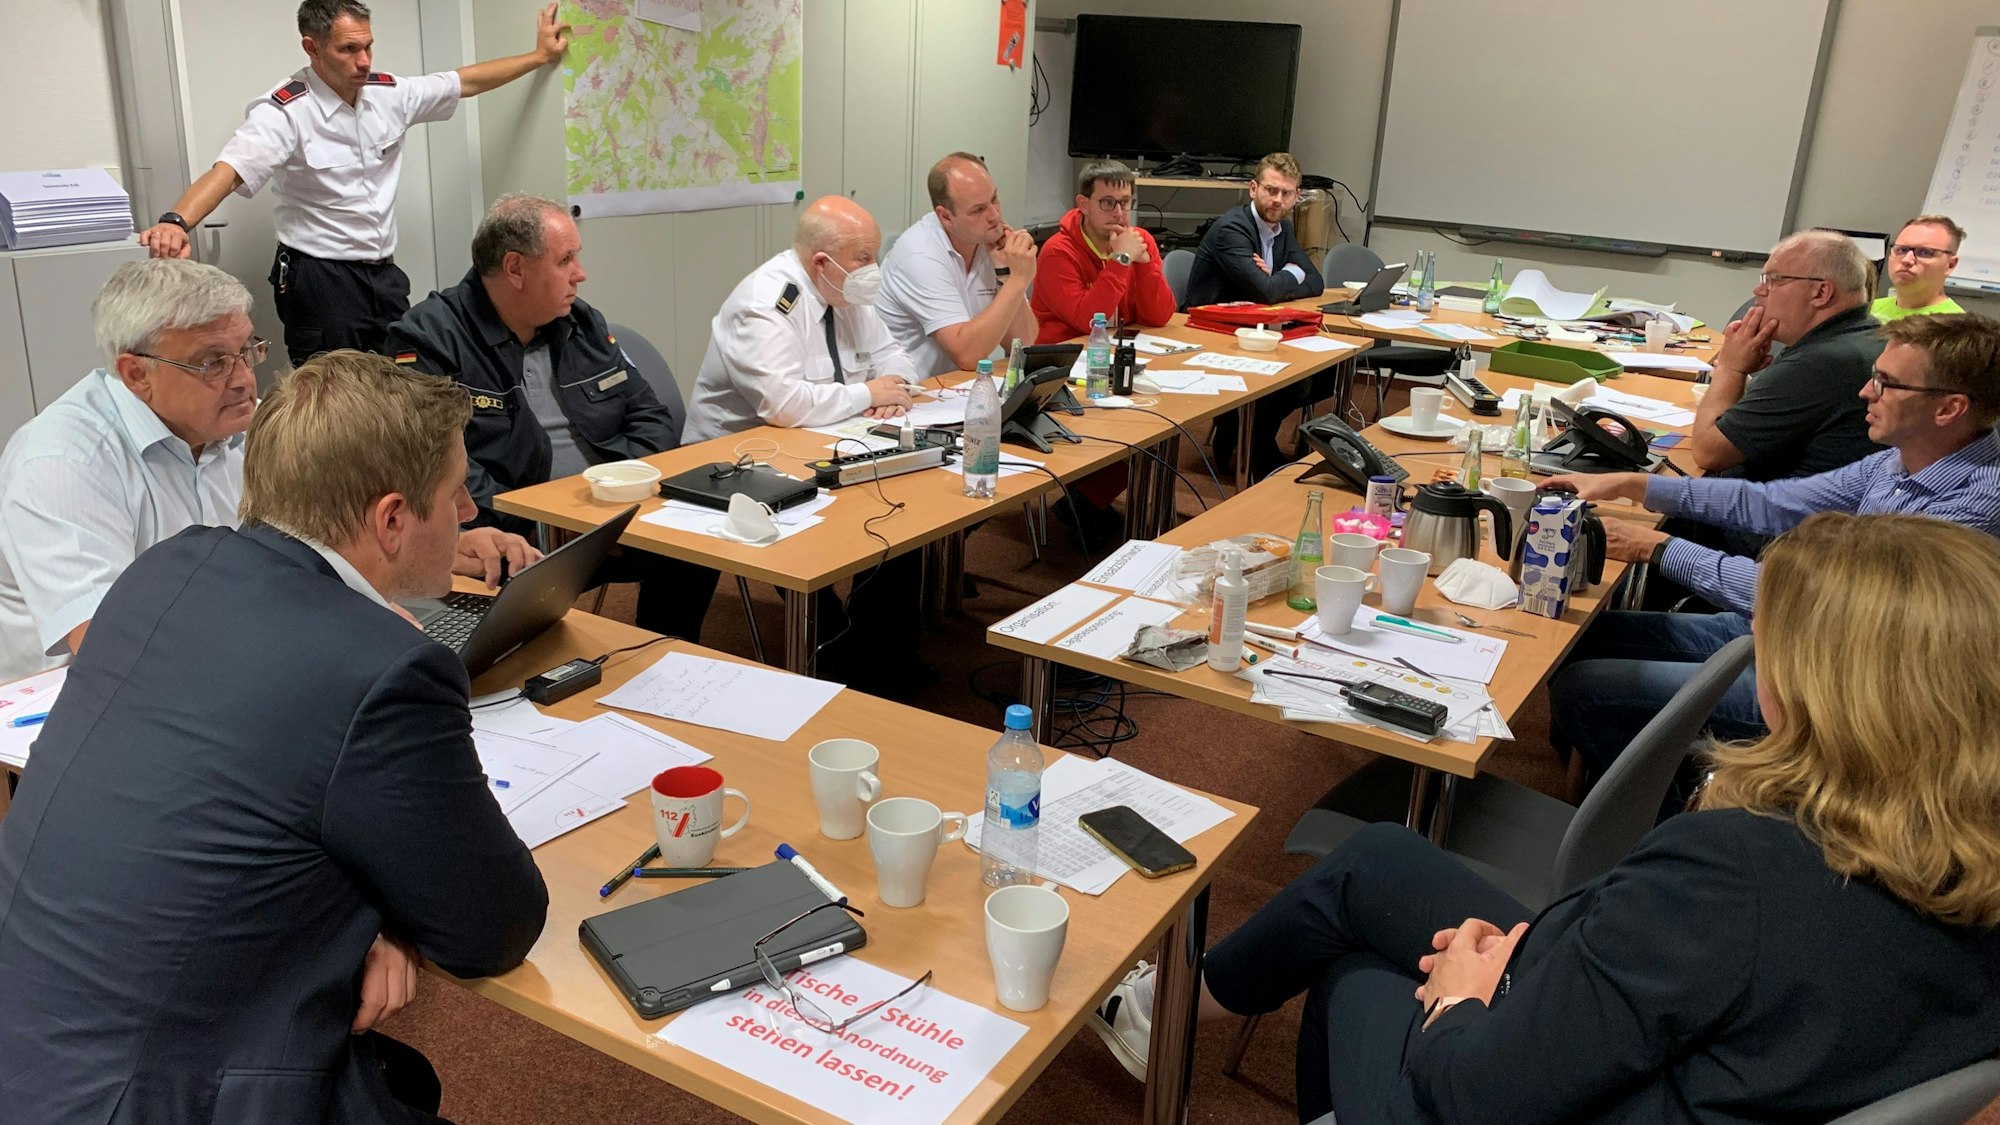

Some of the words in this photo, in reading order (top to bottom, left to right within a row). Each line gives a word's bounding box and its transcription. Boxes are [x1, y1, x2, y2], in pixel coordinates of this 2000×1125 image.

[660, 809, 678, 821] 112
[742, 988, 765, 1004] in
[832, 1023, 950, 1084] Anordnung
[784, 966, 859, 1007] Tische
[880, 1007, 965, 1050] Stühle
[815, 1049, 916, 1101] lassen!
